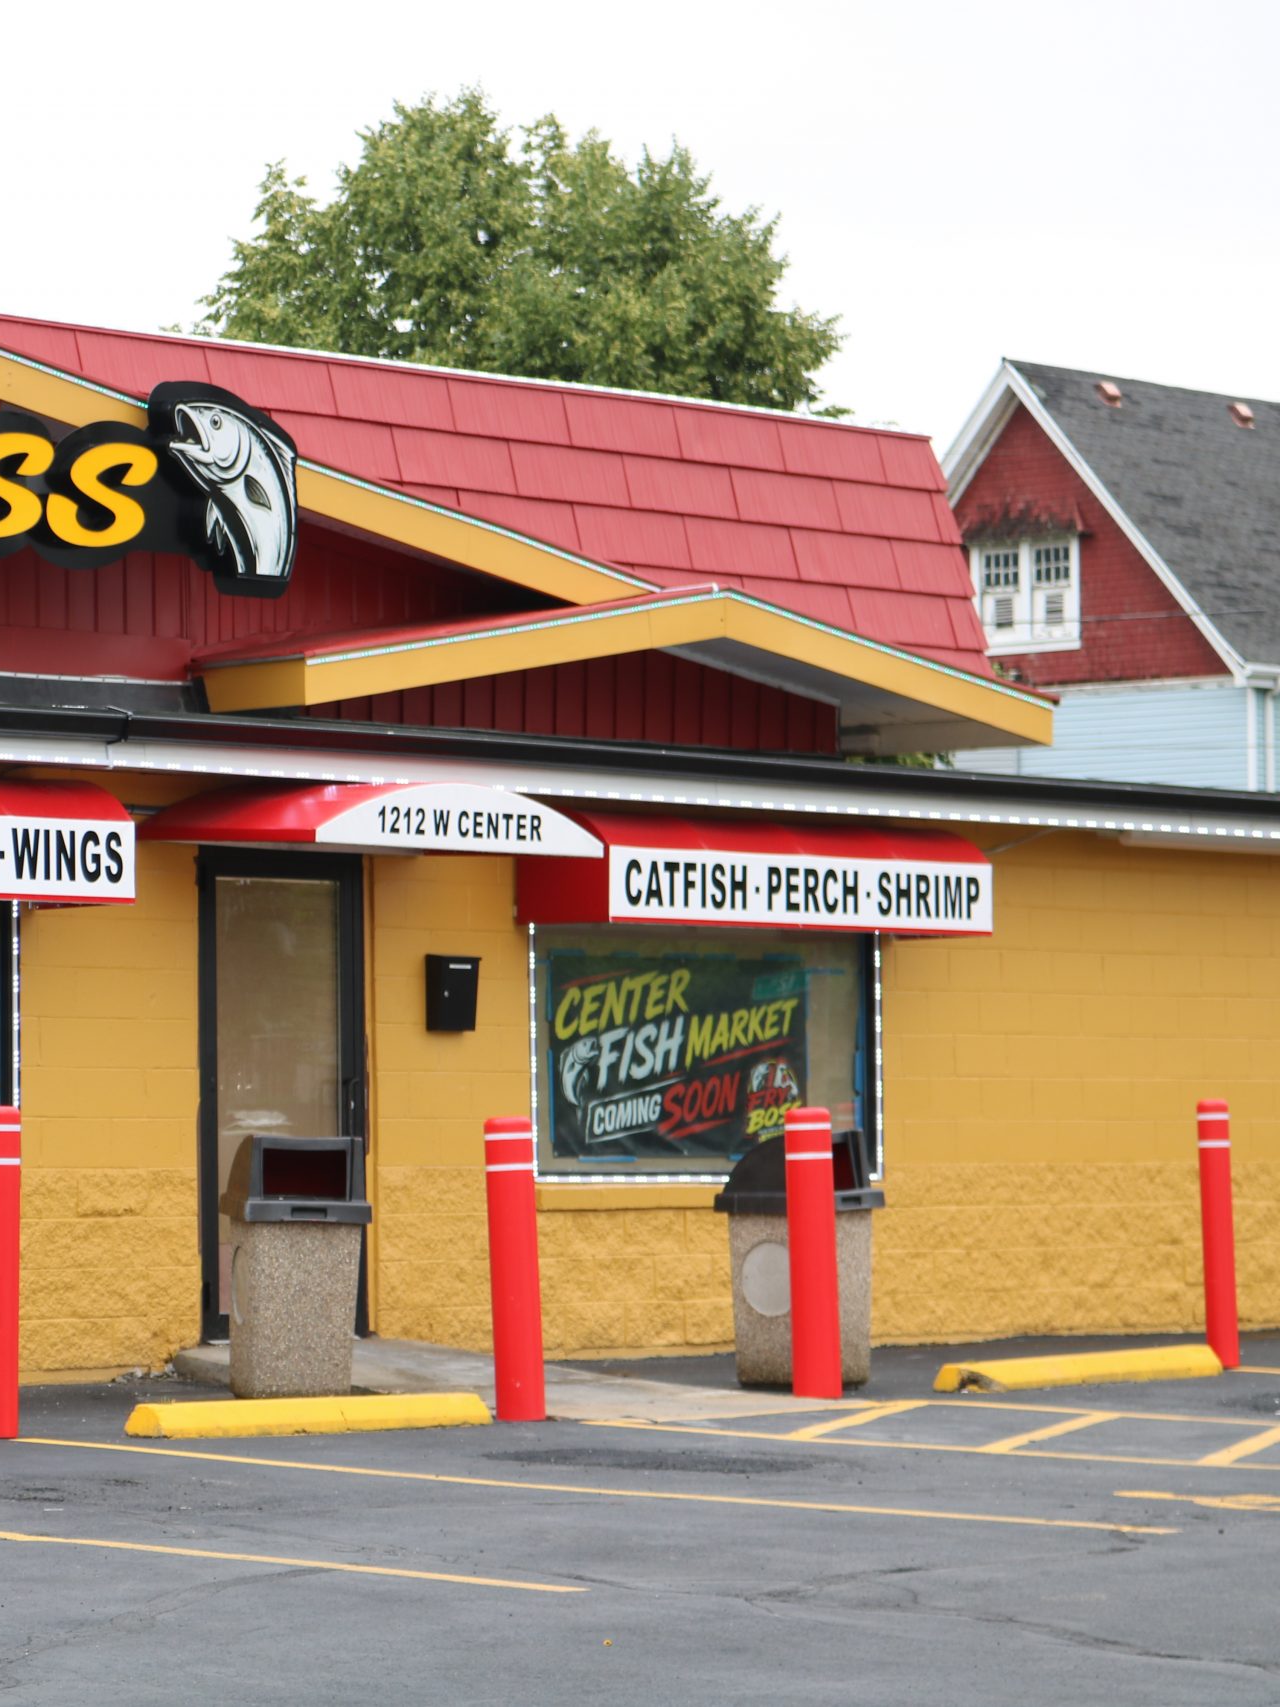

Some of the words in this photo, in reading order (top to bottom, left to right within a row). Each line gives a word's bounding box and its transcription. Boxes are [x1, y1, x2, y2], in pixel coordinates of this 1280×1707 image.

[11, 827, 124, 884] WINGS
[378, 806, 426, 836] 1212
[433, 808, 453, 836] W
[458, 810, 543, 842] CENTER
[625, 858, 748, 910] CATFISH
[767, 866, 860, 916] PERCH
[877, 871, 980, 921] SHRIMP
[554, 968, 690, 1040] CENTER
[597, 1014, 685, 1091] FISH
[686, 999, 799, 1070] MARKET
[592, 1092, 662, 1134] COMING
[657, 1070, 741, 1134] SOON
